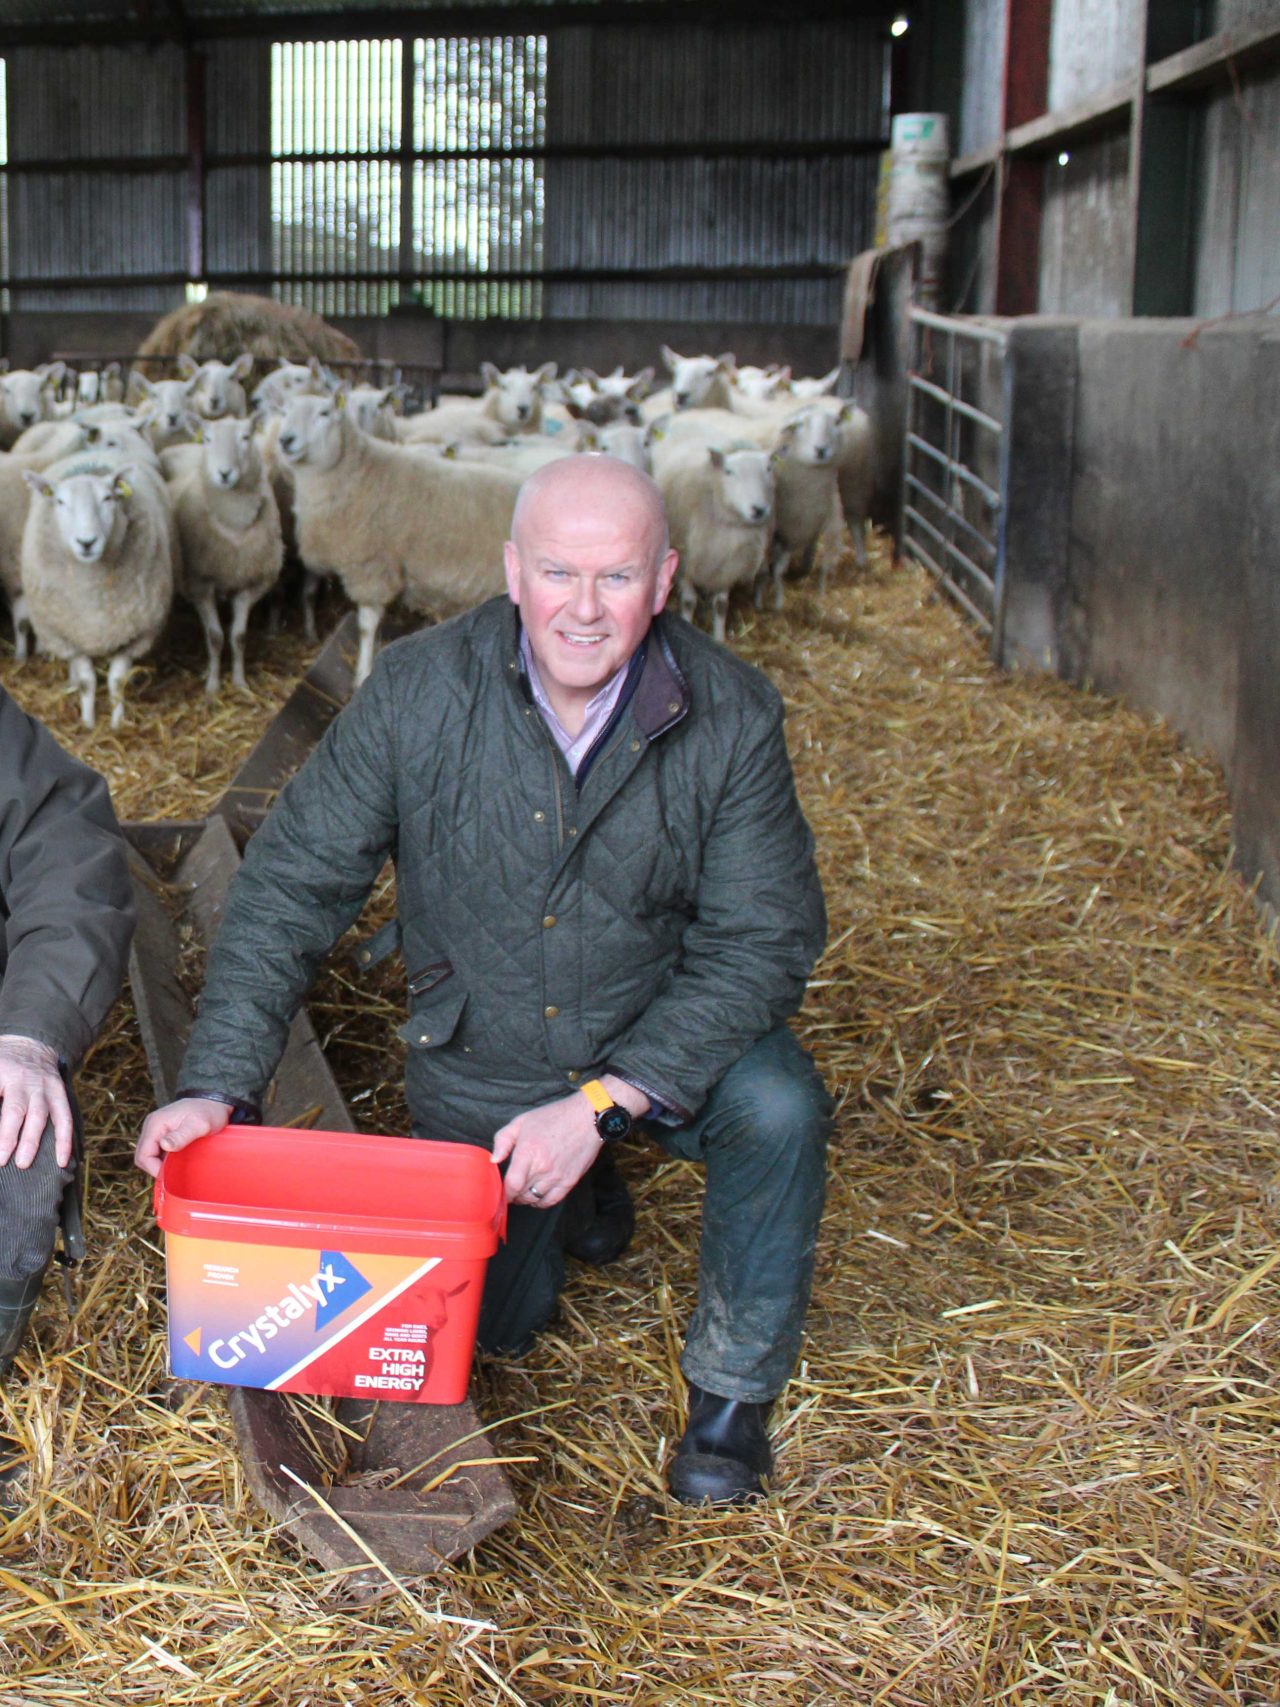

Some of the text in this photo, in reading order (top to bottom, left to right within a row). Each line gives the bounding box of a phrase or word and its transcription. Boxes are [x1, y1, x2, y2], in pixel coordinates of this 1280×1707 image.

[208, 1264, 347, 1369] Crystalyx
[368, 1347, 426, 1363] EXTRA
[381, 1362, 425, 1377] HIGH
[354, 1374, 425, 1391] ENERGY
